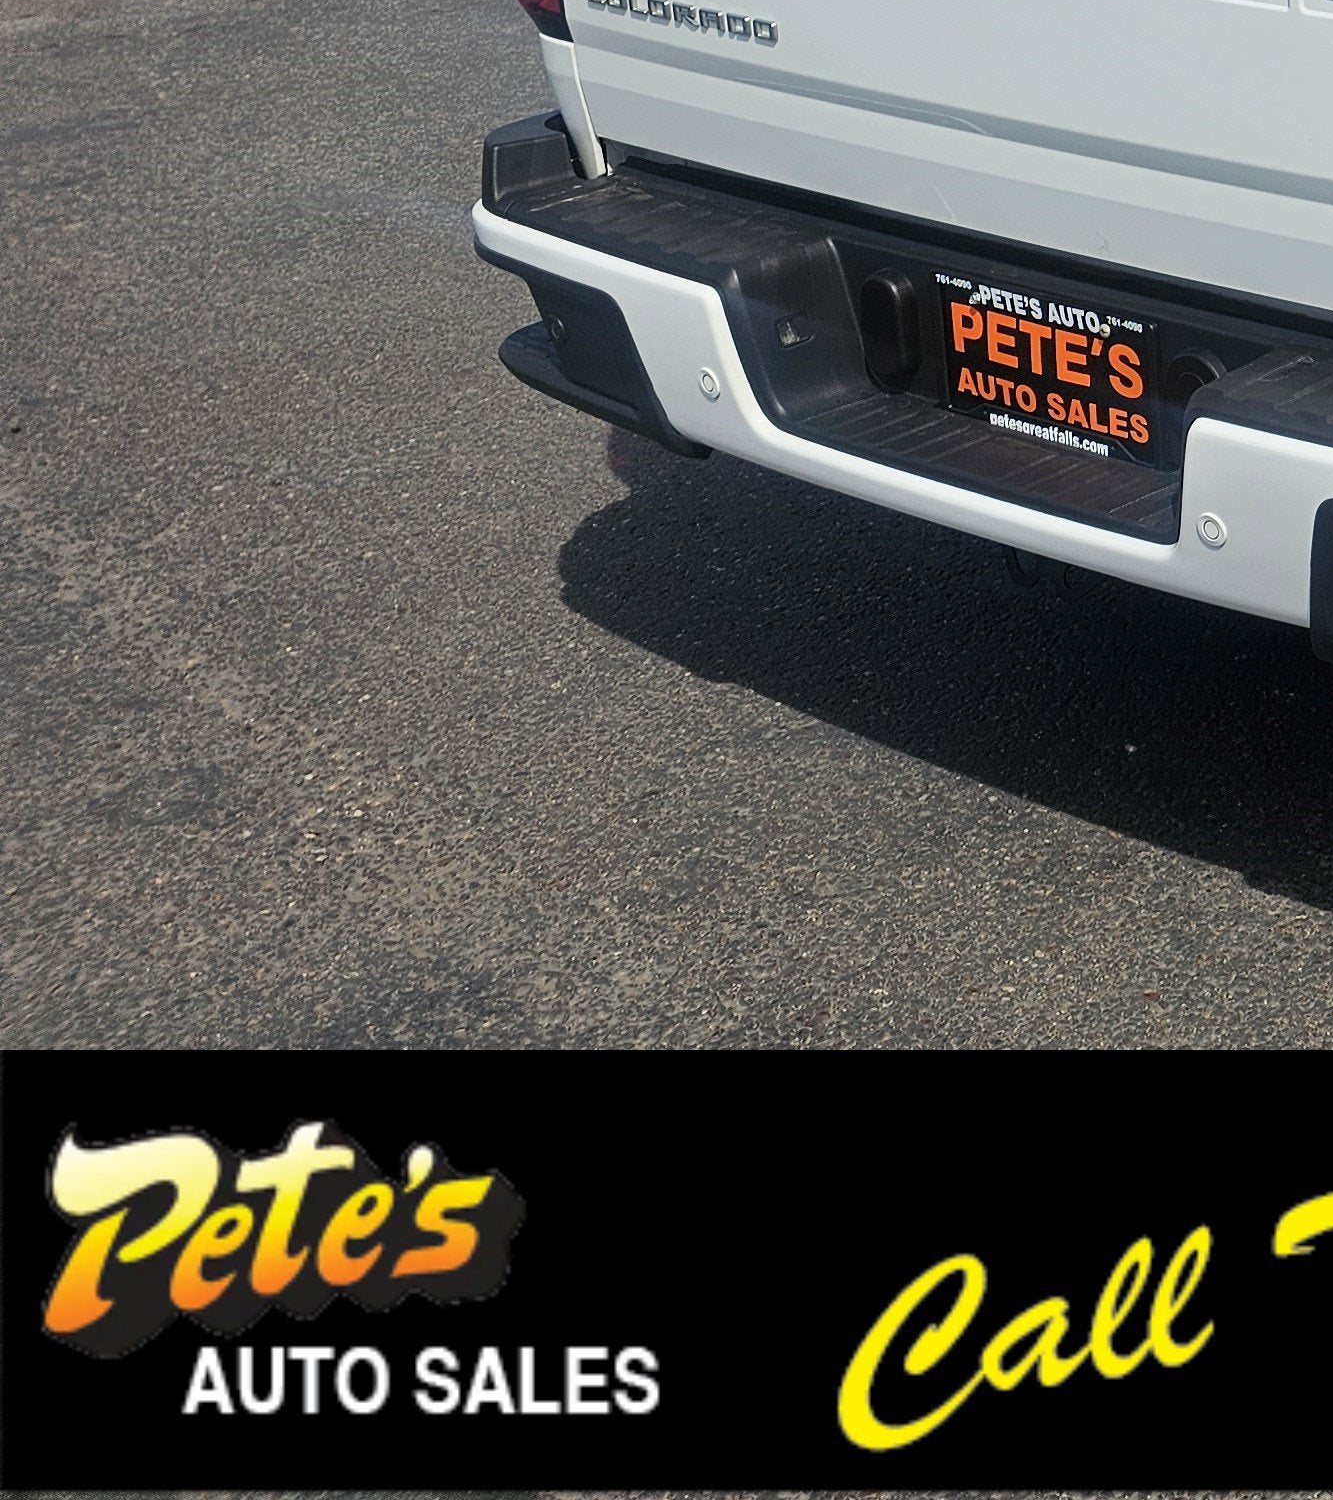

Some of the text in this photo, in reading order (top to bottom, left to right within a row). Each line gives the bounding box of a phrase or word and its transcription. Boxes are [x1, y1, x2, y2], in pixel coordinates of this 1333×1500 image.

[978, 284, 1100, 334] PETE'S AUTO
[1106, 315, 1143, 334] 761-4090
[951, 302, 1144, 399] PETE'S
[958, 367, 1150, 444] AUTO SALES
[989, 411, 1109, 457] petesgreatfalls.com
